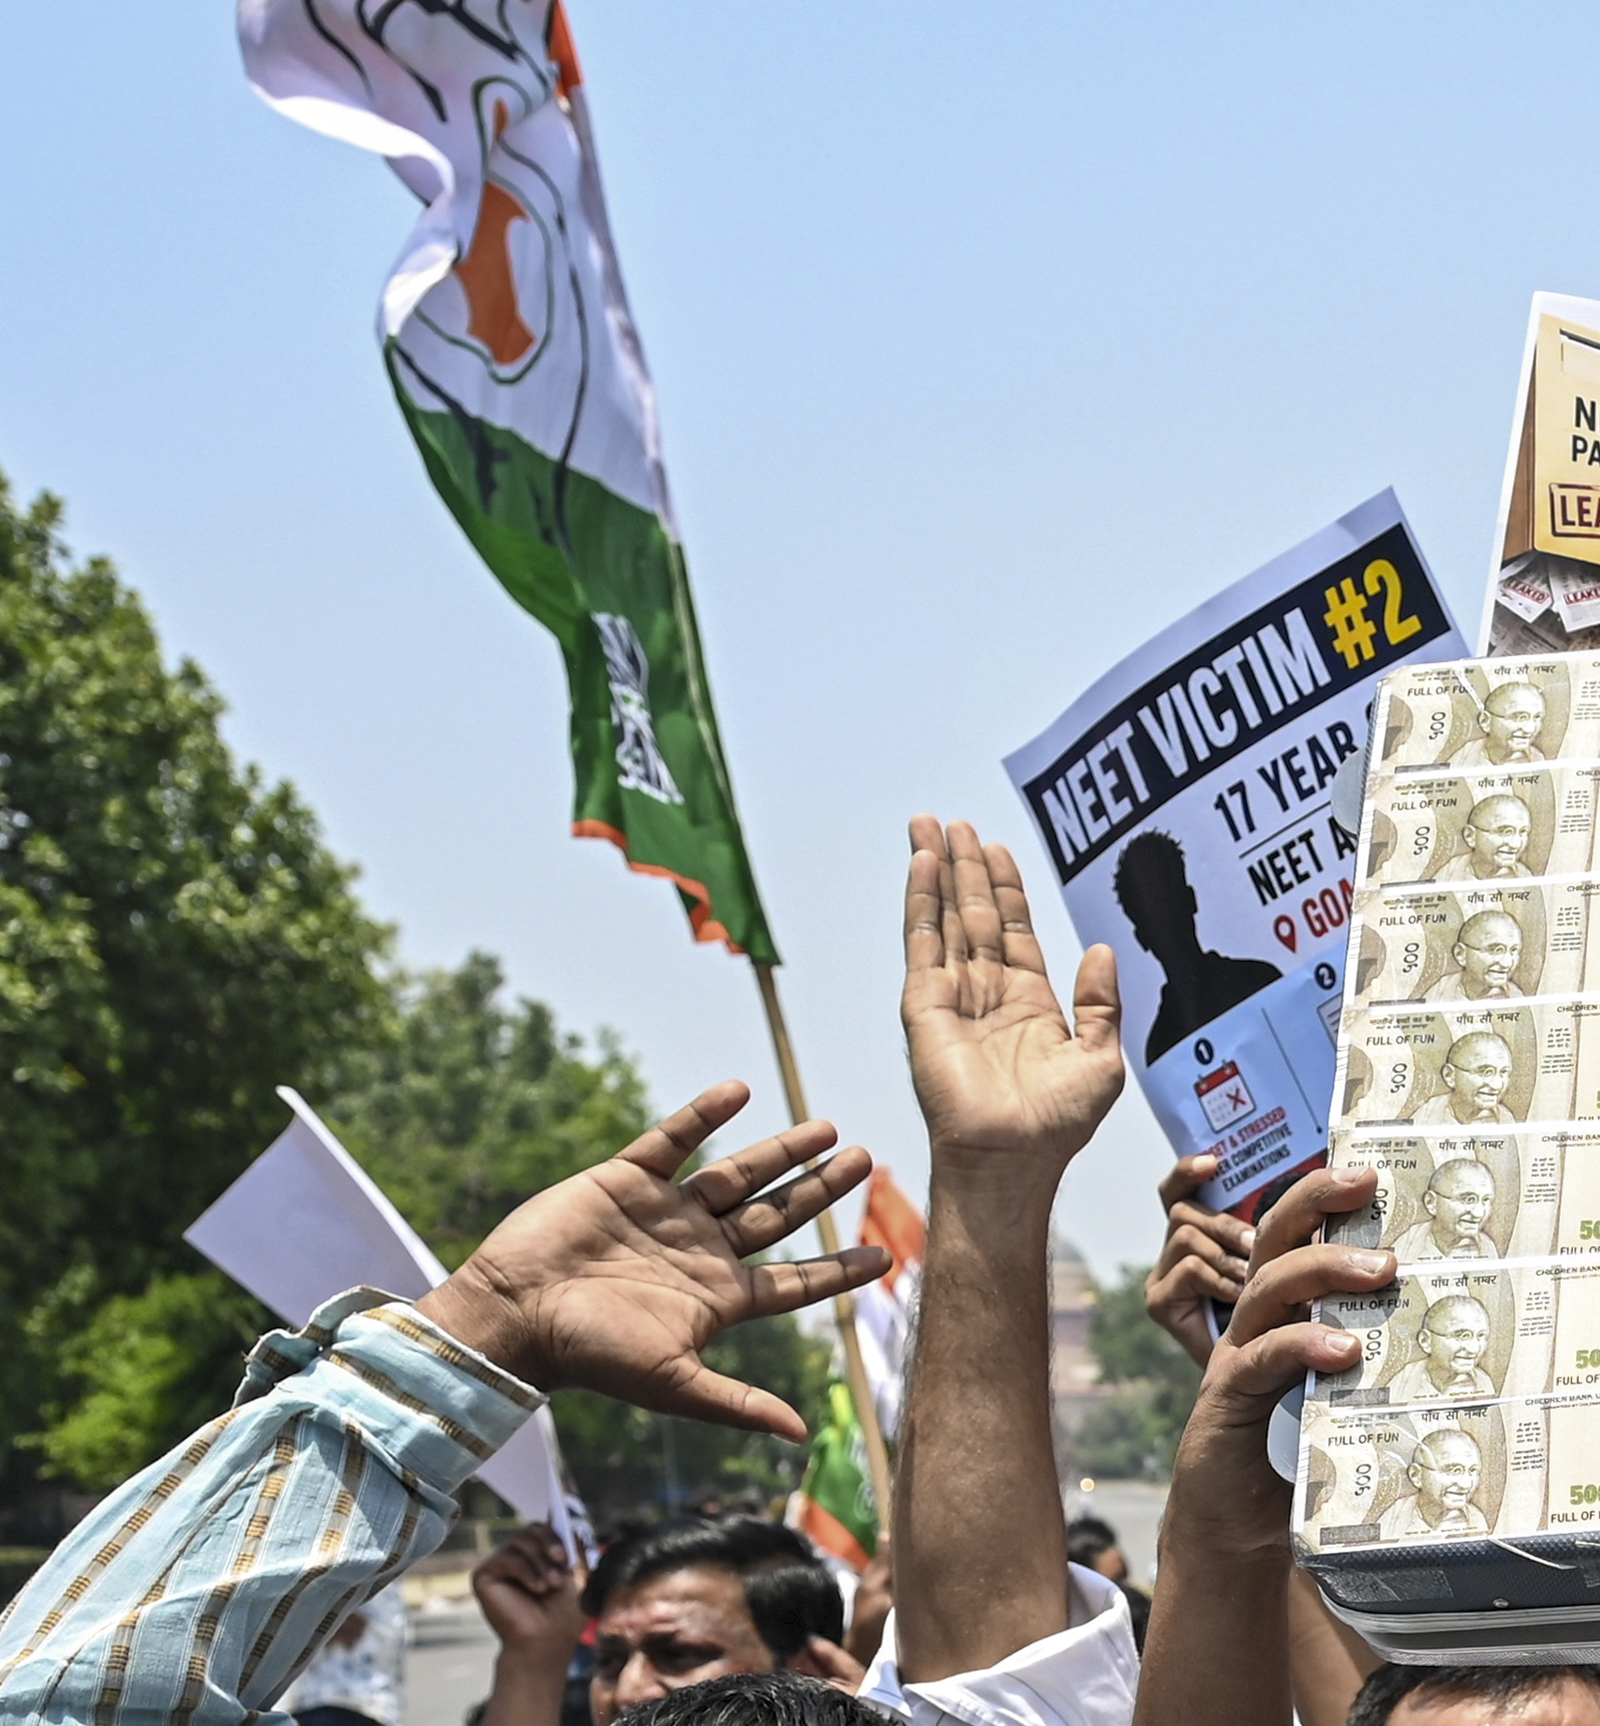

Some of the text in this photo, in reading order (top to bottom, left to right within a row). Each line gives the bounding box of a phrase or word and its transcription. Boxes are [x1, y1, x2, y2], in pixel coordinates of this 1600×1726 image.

[1509, 578, 1546, 601] LEAKED
[1042, 558, 1422, 865] NEET VICTIM #2
[1214, 721, 1358, 842] 17 YEAR
[1391, 798, 1457, 811] FULL OF FUN
[1246, 823, 1332, 906] NEET
[1319, 966, 1334, 987] 2
[1199, 1043, 1210, 1062] 1
[1366, 1034, 1435, 1046] FULL OF FUN
[1228, 1134, 1238, 1148] &
[1237, 1106, 1286, 1142] STRESSED
[1231, 1122, 1292, 1166] COMPETITIVE
[1222, 1144, 1290, 1192] EXAMINATIONS
